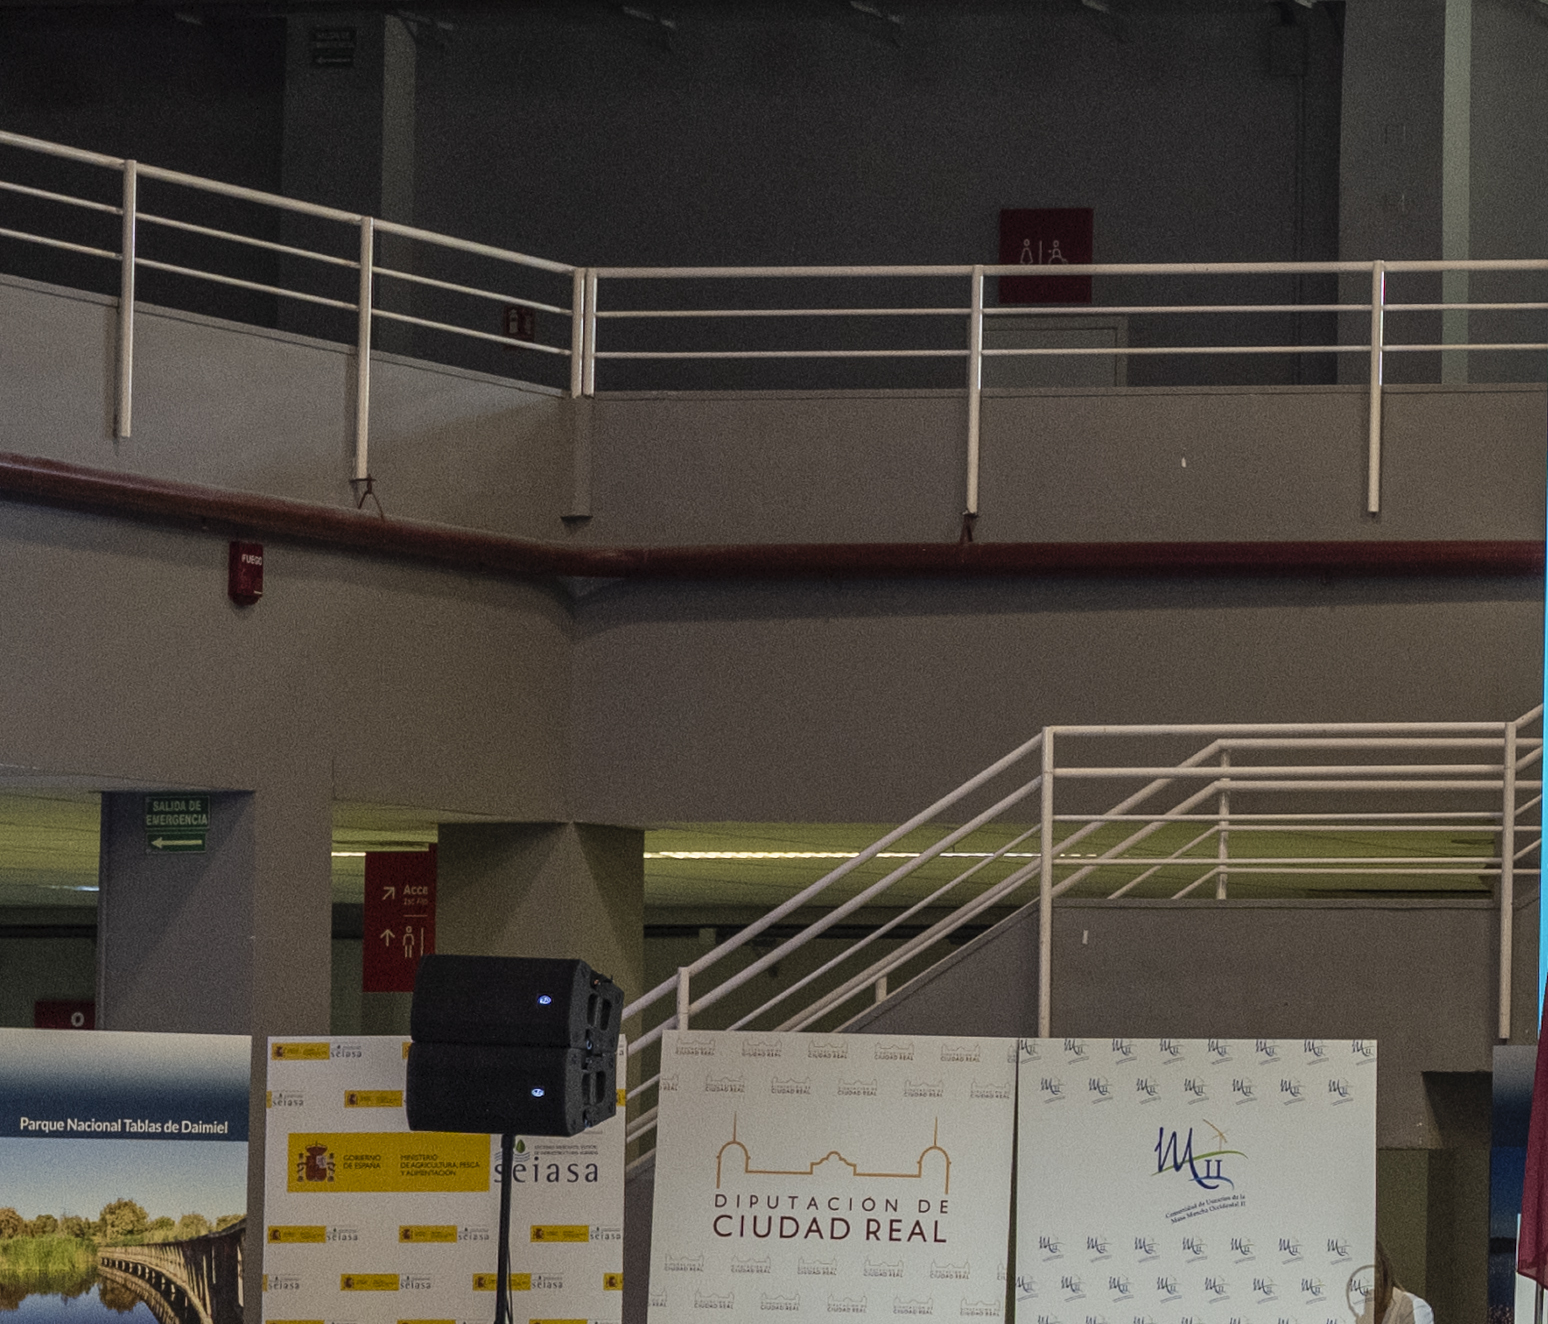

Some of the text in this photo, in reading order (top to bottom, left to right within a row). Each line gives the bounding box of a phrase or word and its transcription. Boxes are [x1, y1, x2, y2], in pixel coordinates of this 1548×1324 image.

[20, 1117, 228, 1133] Parque Nacional Tablas de Daimiel
[494, 1156, 600, 1184] seiasa
[715, 1194, 948, 1214] DIPUTACIÓN DE
[713, 1214, 947, 1242] CIUDAD REAL
